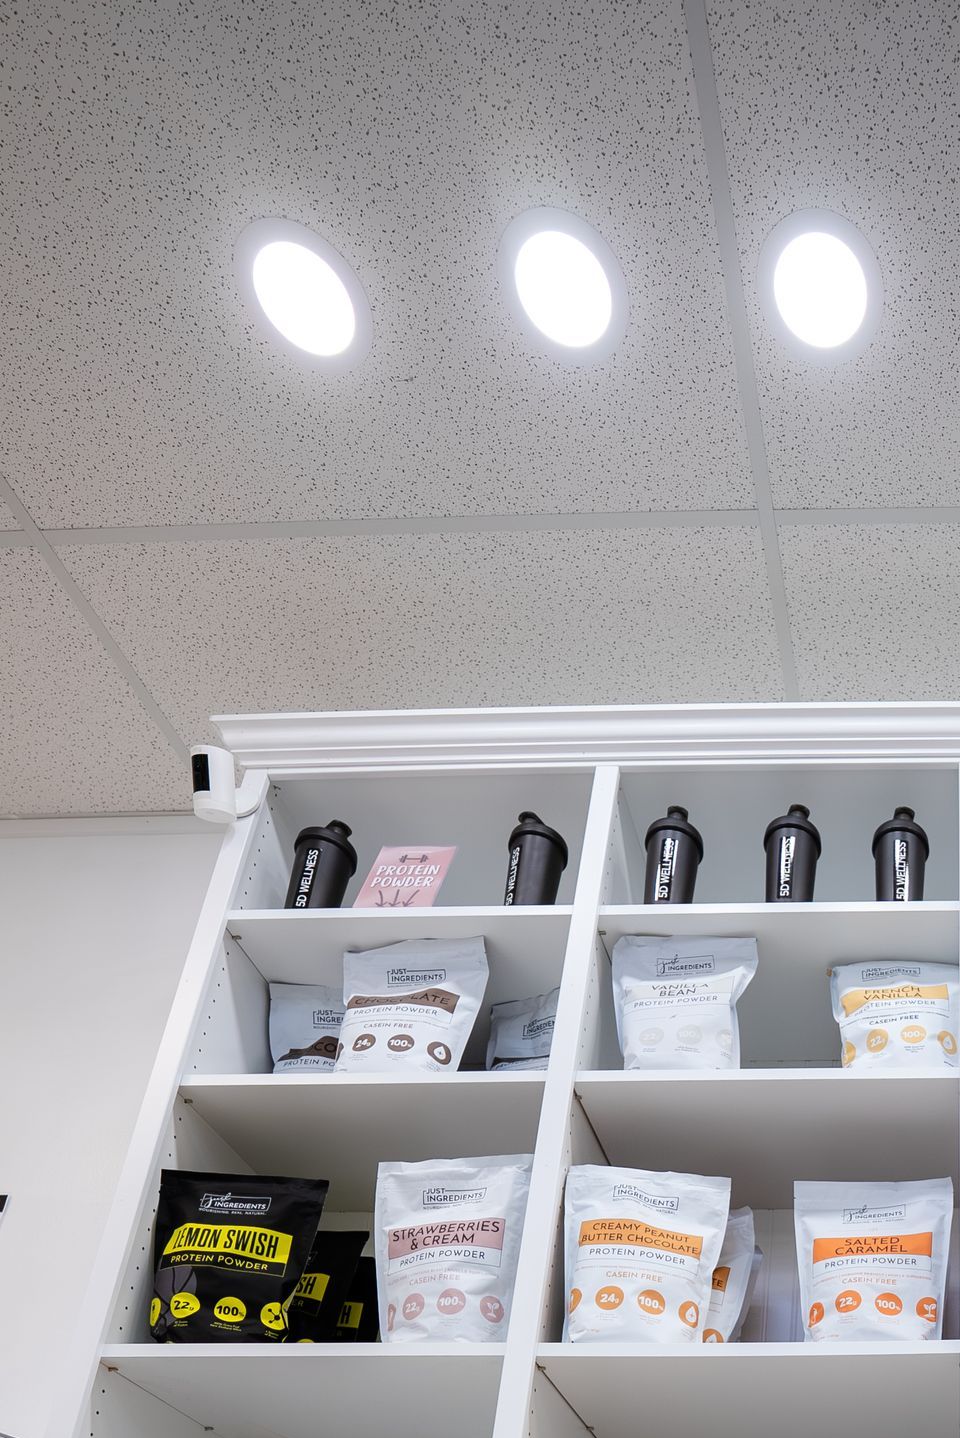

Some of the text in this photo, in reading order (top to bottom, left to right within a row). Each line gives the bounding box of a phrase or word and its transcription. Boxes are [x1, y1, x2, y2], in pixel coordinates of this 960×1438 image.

[376, 865, 440, 876] PROTEIN
[658, 838, 675, 898] 5D WELLNESS
[296, 849, 319, 907] 5D WELLNESS
[370, 877, 434, 888] POWDER
[668, 963, 712, 971] INGREDIENTS
[659, 989, 696, 997] BEAN
[353, 1006, 437, 1015] PROTEIN POWDER
[634, 1000, 673, 1008] PROTEIN
[427, 1192, 482, 1202] INGREDIENTS
[618, 1190, 675, 1208] INGREDIENTS
[855, 1211, 903, 1220] INGREDIENTS
[392, 1221, 500, 1242] STRAWBERRIES
[593, 1223, 689, 1243] CREAMY PEANUT
[173, 1227, 279, 1258] LEMON SWISH
[410, 1233, 475, 1250] & CREAM
[582, 1233, 698, 1254] BUTTER CHOCOLATE
[845, 1238, 900, 1246] SALTED
[589, 1248, 685, 1265] PROTEIN POWDER
[835, 1245, 908, 1255] CARAMEL
[171, 1254, 268, 1270] PROTEIN POWDER
[400, 1250, 485, 1267] PROTEIN POWDER
[824, 1258, 868, 1269] PROTEIN
